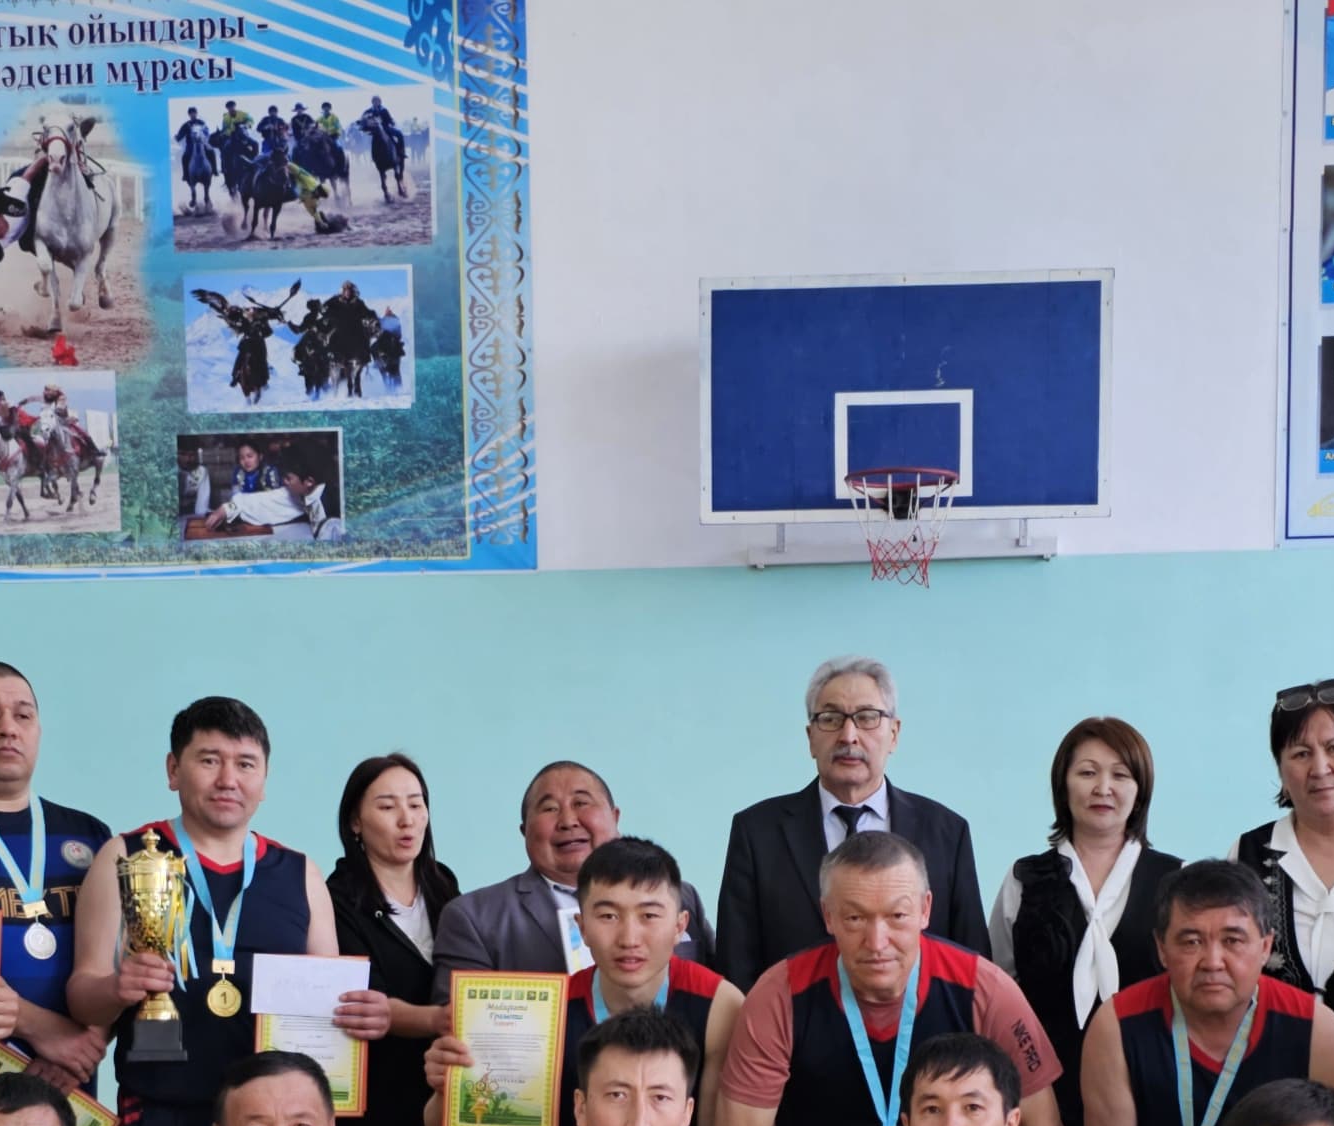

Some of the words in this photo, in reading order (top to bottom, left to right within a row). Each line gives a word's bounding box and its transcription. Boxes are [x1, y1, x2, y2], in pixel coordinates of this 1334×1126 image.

[68, 14, 245, 50] ойындары
[107, 57, 234, 92] мұрасы
[220, 991, 227, 1005] 1
